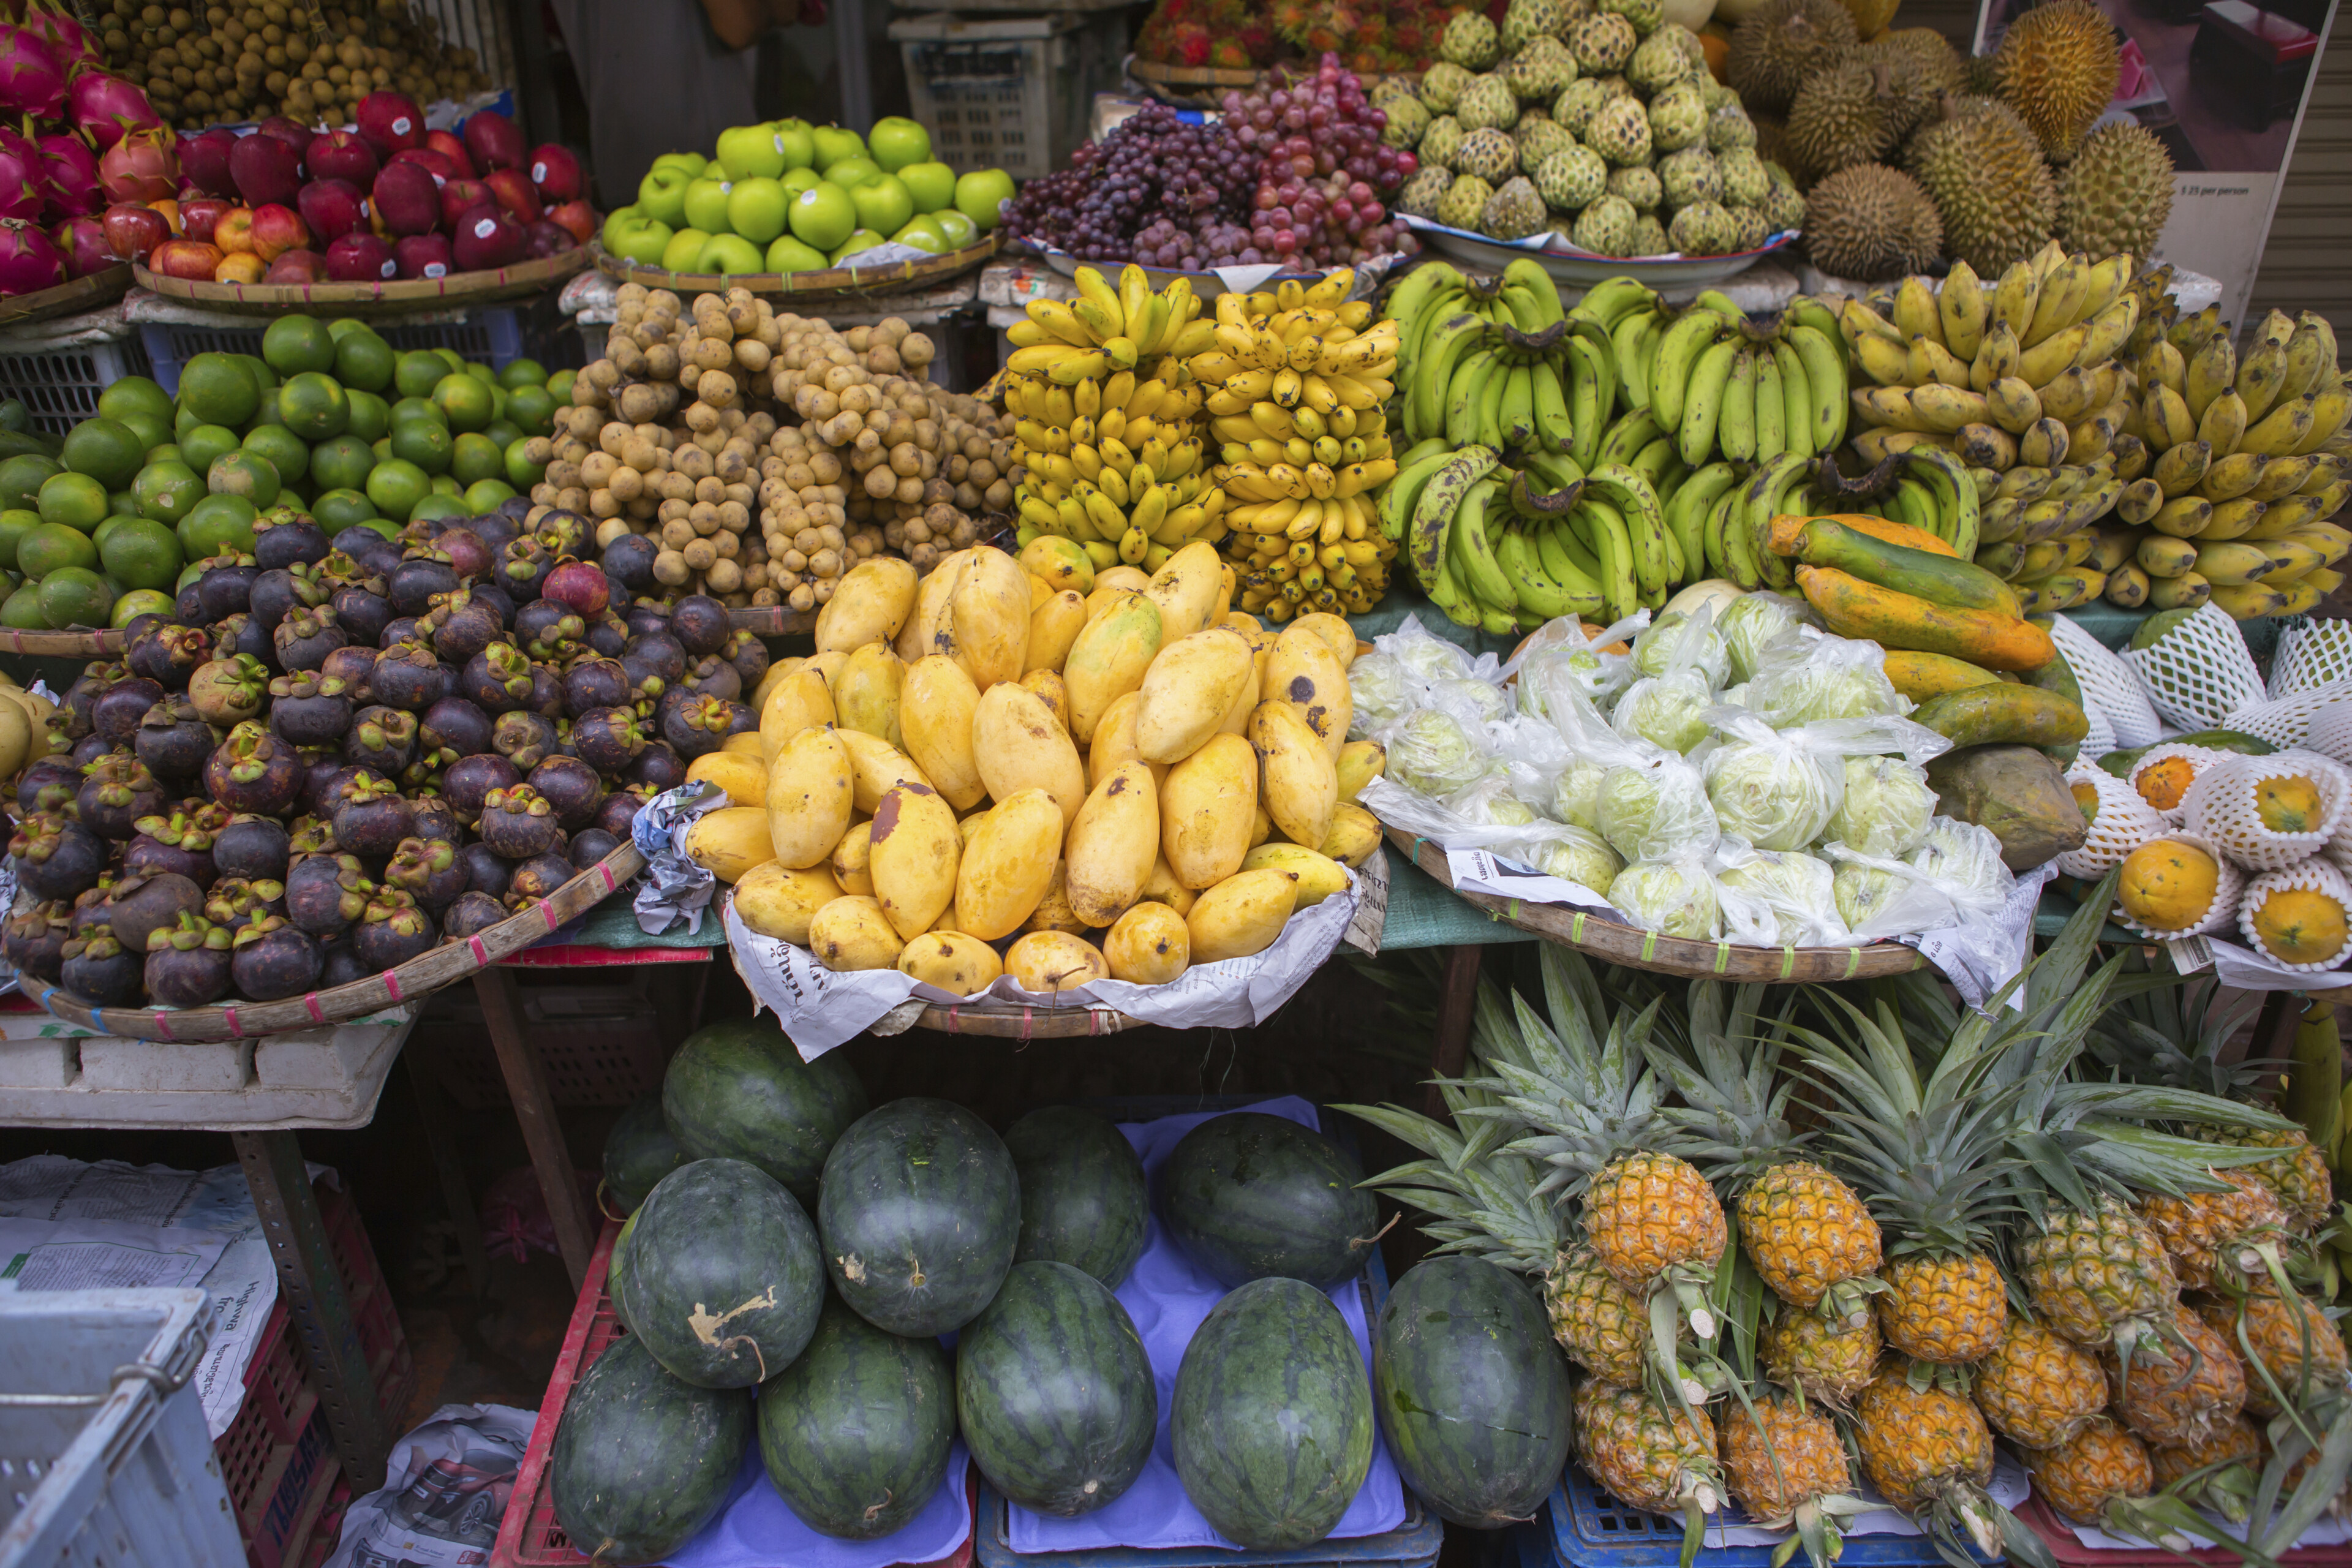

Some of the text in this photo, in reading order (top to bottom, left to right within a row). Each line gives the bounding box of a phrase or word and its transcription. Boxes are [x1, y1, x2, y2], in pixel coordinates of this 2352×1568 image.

[2201, 187, 2216, 197] per
[2217, 187, 2249, 197] person
[215, 1296, 234, 1315] fro
[224, 1281, 260, 1332] Highwa
